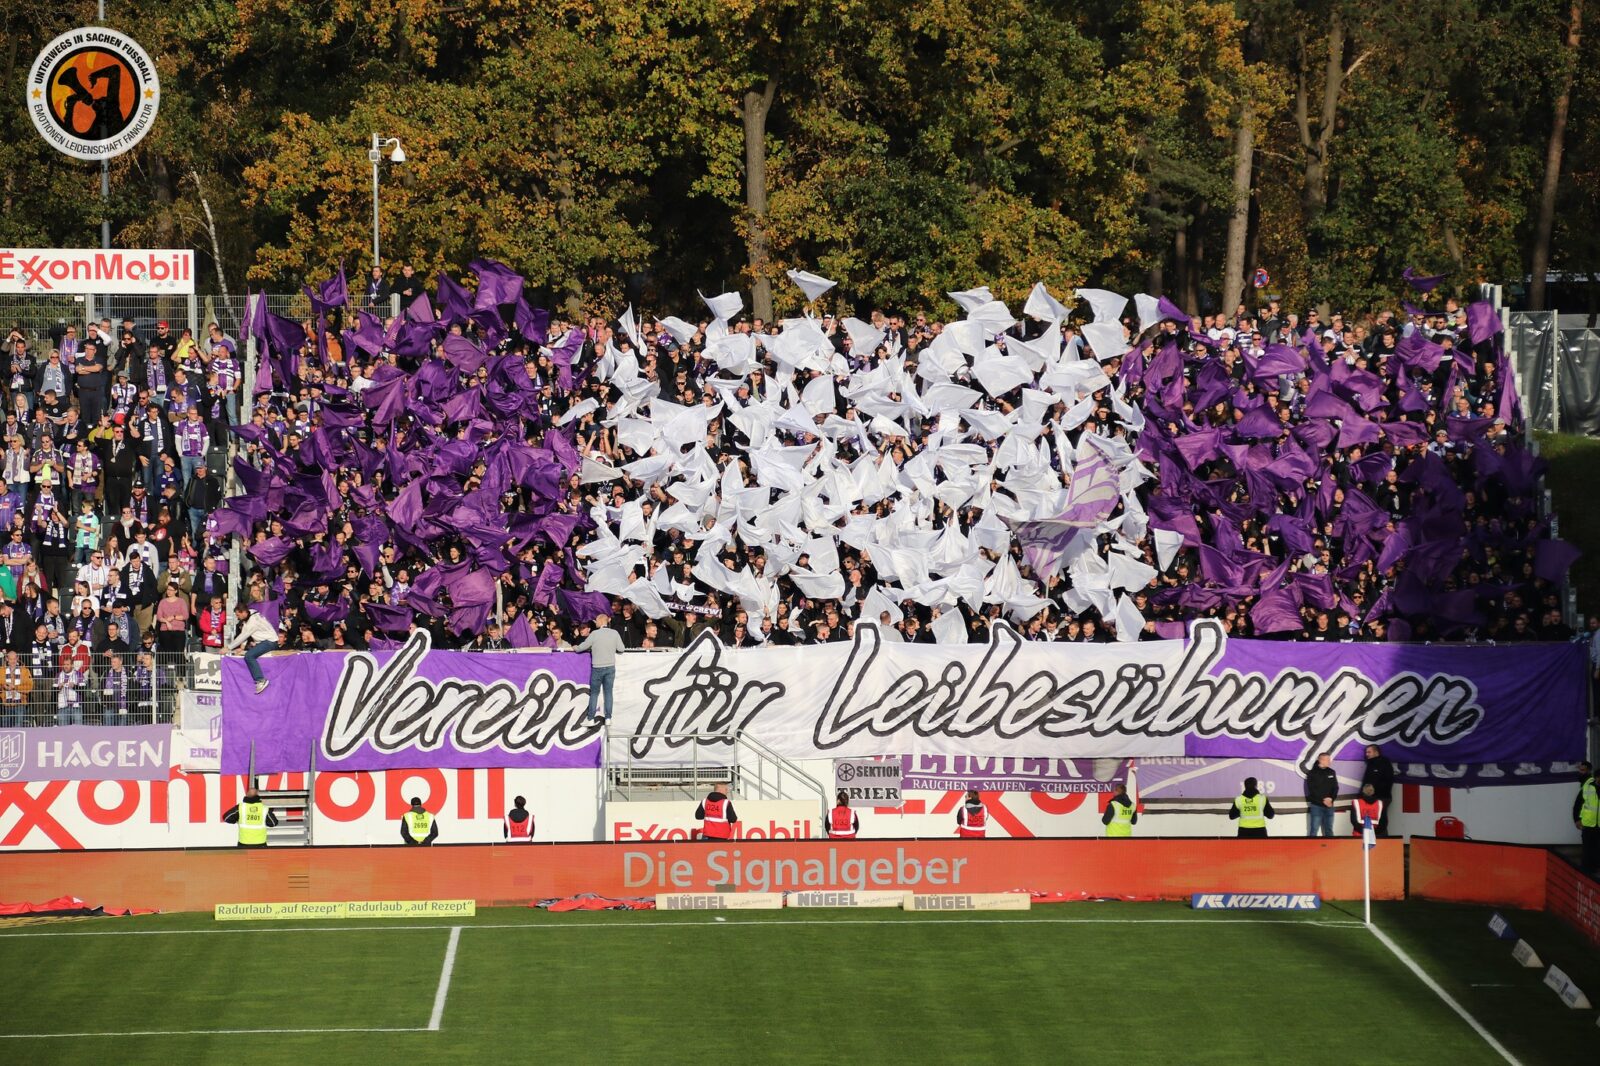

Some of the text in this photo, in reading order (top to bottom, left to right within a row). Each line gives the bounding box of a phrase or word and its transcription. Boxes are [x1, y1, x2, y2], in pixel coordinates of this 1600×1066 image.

[0, 252, 189, 289] ExxonMobil
[197, 695, 216, 706] EIN
[321, 619, 1484, 775] Verein für Leibesübungen
[38, 740, 164, 768] HAGEN
[190, 748, 217, 758] EINE
[856, 766, 900, 778] SEKTION
[913, 779, 969, 791] RAUCHEN
[983, 781, 1027, 791] SAUFEN
[1040, 783, 1112, 793] SCHMEISSEN
[837, 788, 899, 800] TRIER
[614, 820, 810, 840] Exxoobil
[624, 848, 967, 893] Die Signalgeber
[666, 894, 728, 910] NÖGEL
[797, 891, 858, 907] NÖGEL
[914, 894, 975, 910] NÖGEL
[1226, 895, 1288, 908] KUZKA
[218, 904, 272, 915] Radurlaub
[348, 902, 402, 912] Radurlaub
